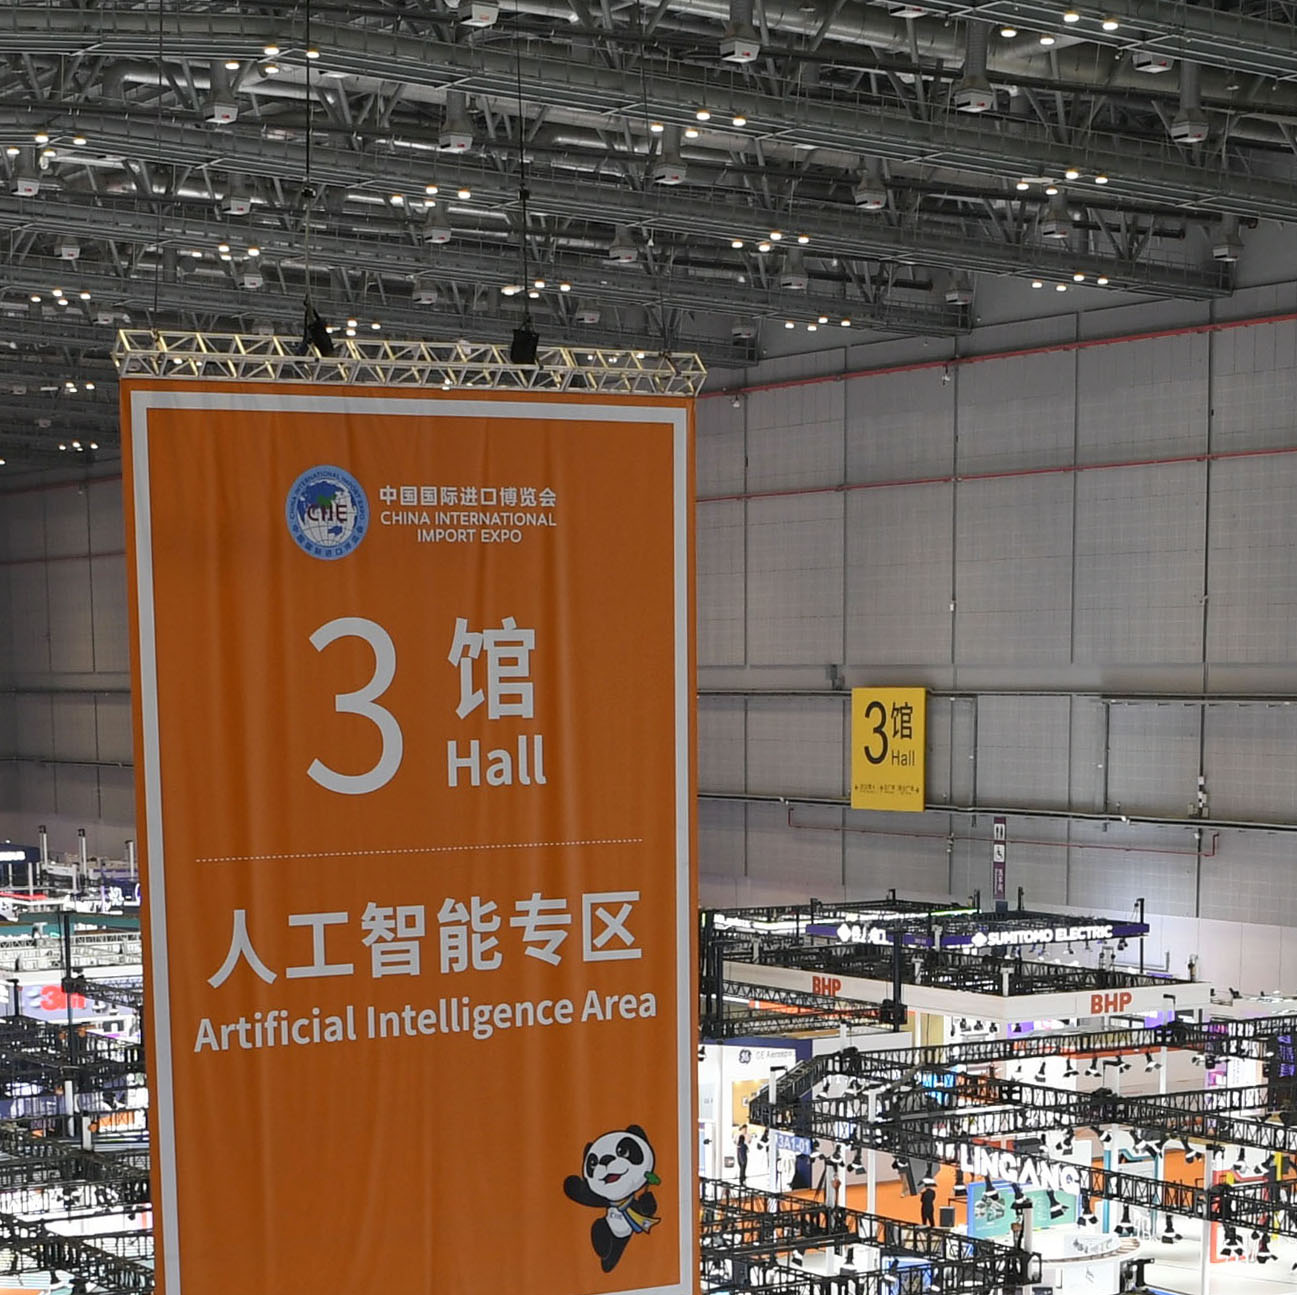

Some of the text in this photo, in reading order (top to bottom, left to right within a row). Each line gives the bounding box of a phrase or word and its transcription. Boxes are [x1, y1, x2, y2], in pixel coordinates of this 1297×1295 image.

[379, 485, 557, 507] 中国国际进口博览会
[380, 511, 557, 527] CHINA INTERNATIONAL
[417, 529, 522, 544] IMPORT EXPO
[448, 616, 536, 720] 馆
[307, 617, 404, 795] 3
[891, 702, 913, 740] 馆
[864, 701, 888, 765] 3
[447, 735, 547, 788] Hall
[891, 750, 915, 766] Hall
[207, 890, 643, 989] 人工智能专区
[987, 925, 1113, 945] SUMITOMO ELECTRIC
[812, 975, 842, 997] BHP
[1090, 992, 1133, 1014] BHP
[194, 989, 657, 1053] Artificial Intelligence Area
[960, 1142, 1080, 1196] LINGANG
